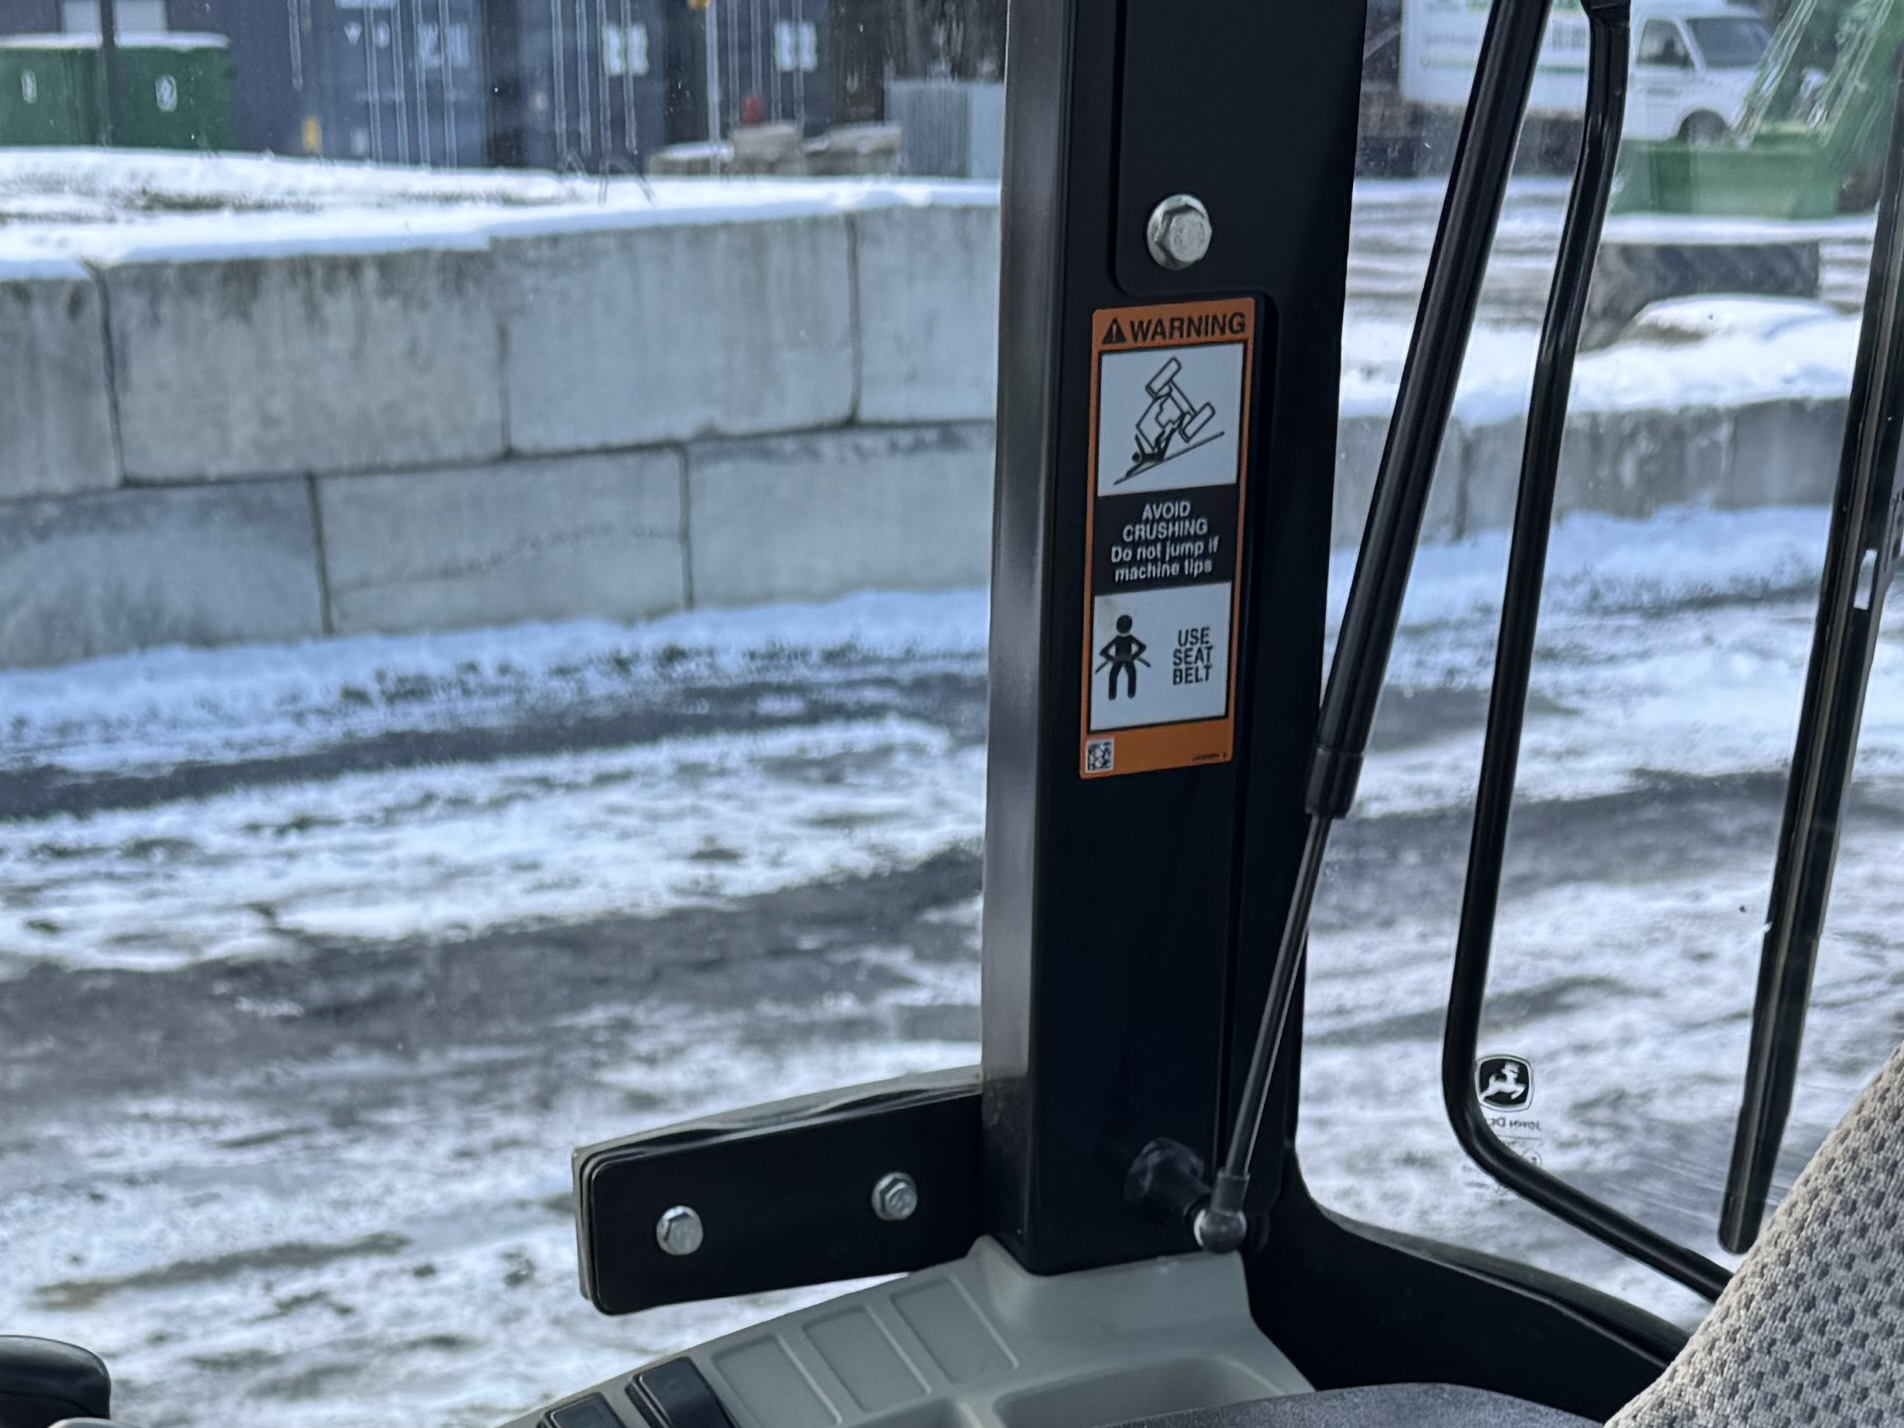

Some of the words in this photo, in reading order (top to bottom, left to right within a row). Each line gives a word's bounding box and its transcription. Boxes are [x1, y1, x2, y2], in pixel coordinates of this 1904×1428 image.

[1130, 311, 1246, 342] WARNING
[1142, 500, 1191, 520] AVOID
[1122, 518, 1208, 542] CRUSHING
[1111, 546, 1132, 563] Do
[1137, 542, 1161, 561] not
[1165, 540, 1204, 563] jump
[1208, 535, 1219, 553] if
[1115, 562, 1180, 582] machine
[1184, 558, 1213, 578] tips
[1178, 626, 1210, 647] USE
[1173, 645, 1213, 666] SEAT
[1173, 664, 1213, 685] BELT
